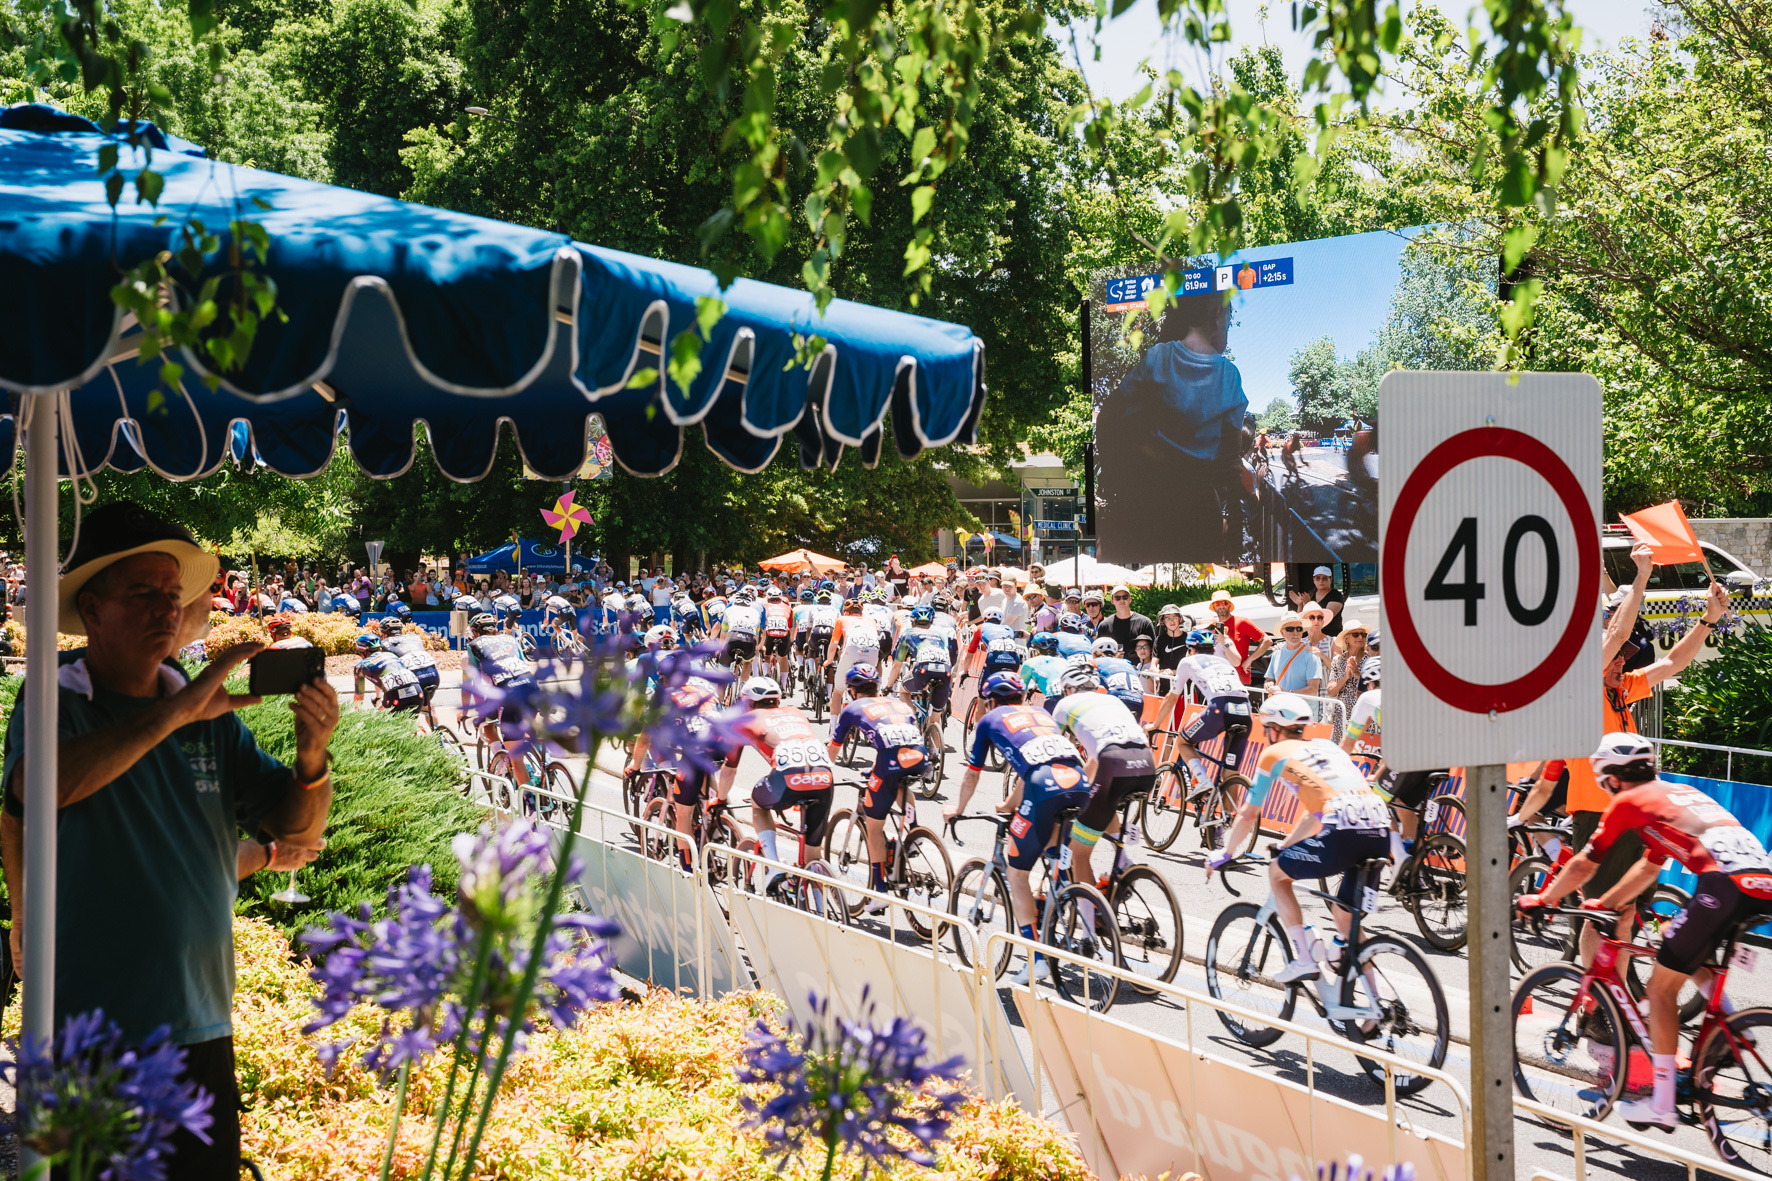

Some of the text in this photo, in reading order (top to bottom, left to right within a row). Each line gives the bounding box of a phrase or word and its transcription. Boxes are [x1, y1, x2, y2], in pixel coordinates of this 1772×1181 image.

[1221, 273, 1228, 283] P
[1037, 488, 1064, 496] JOHNSTON
[1037, 521, 1072, 530] MEDICAL CLINIC
[1424, 514, 1560, 627] 40
[789, 774, 831, 787] caps
[1286, 766, 1323, 790] SCOTT
